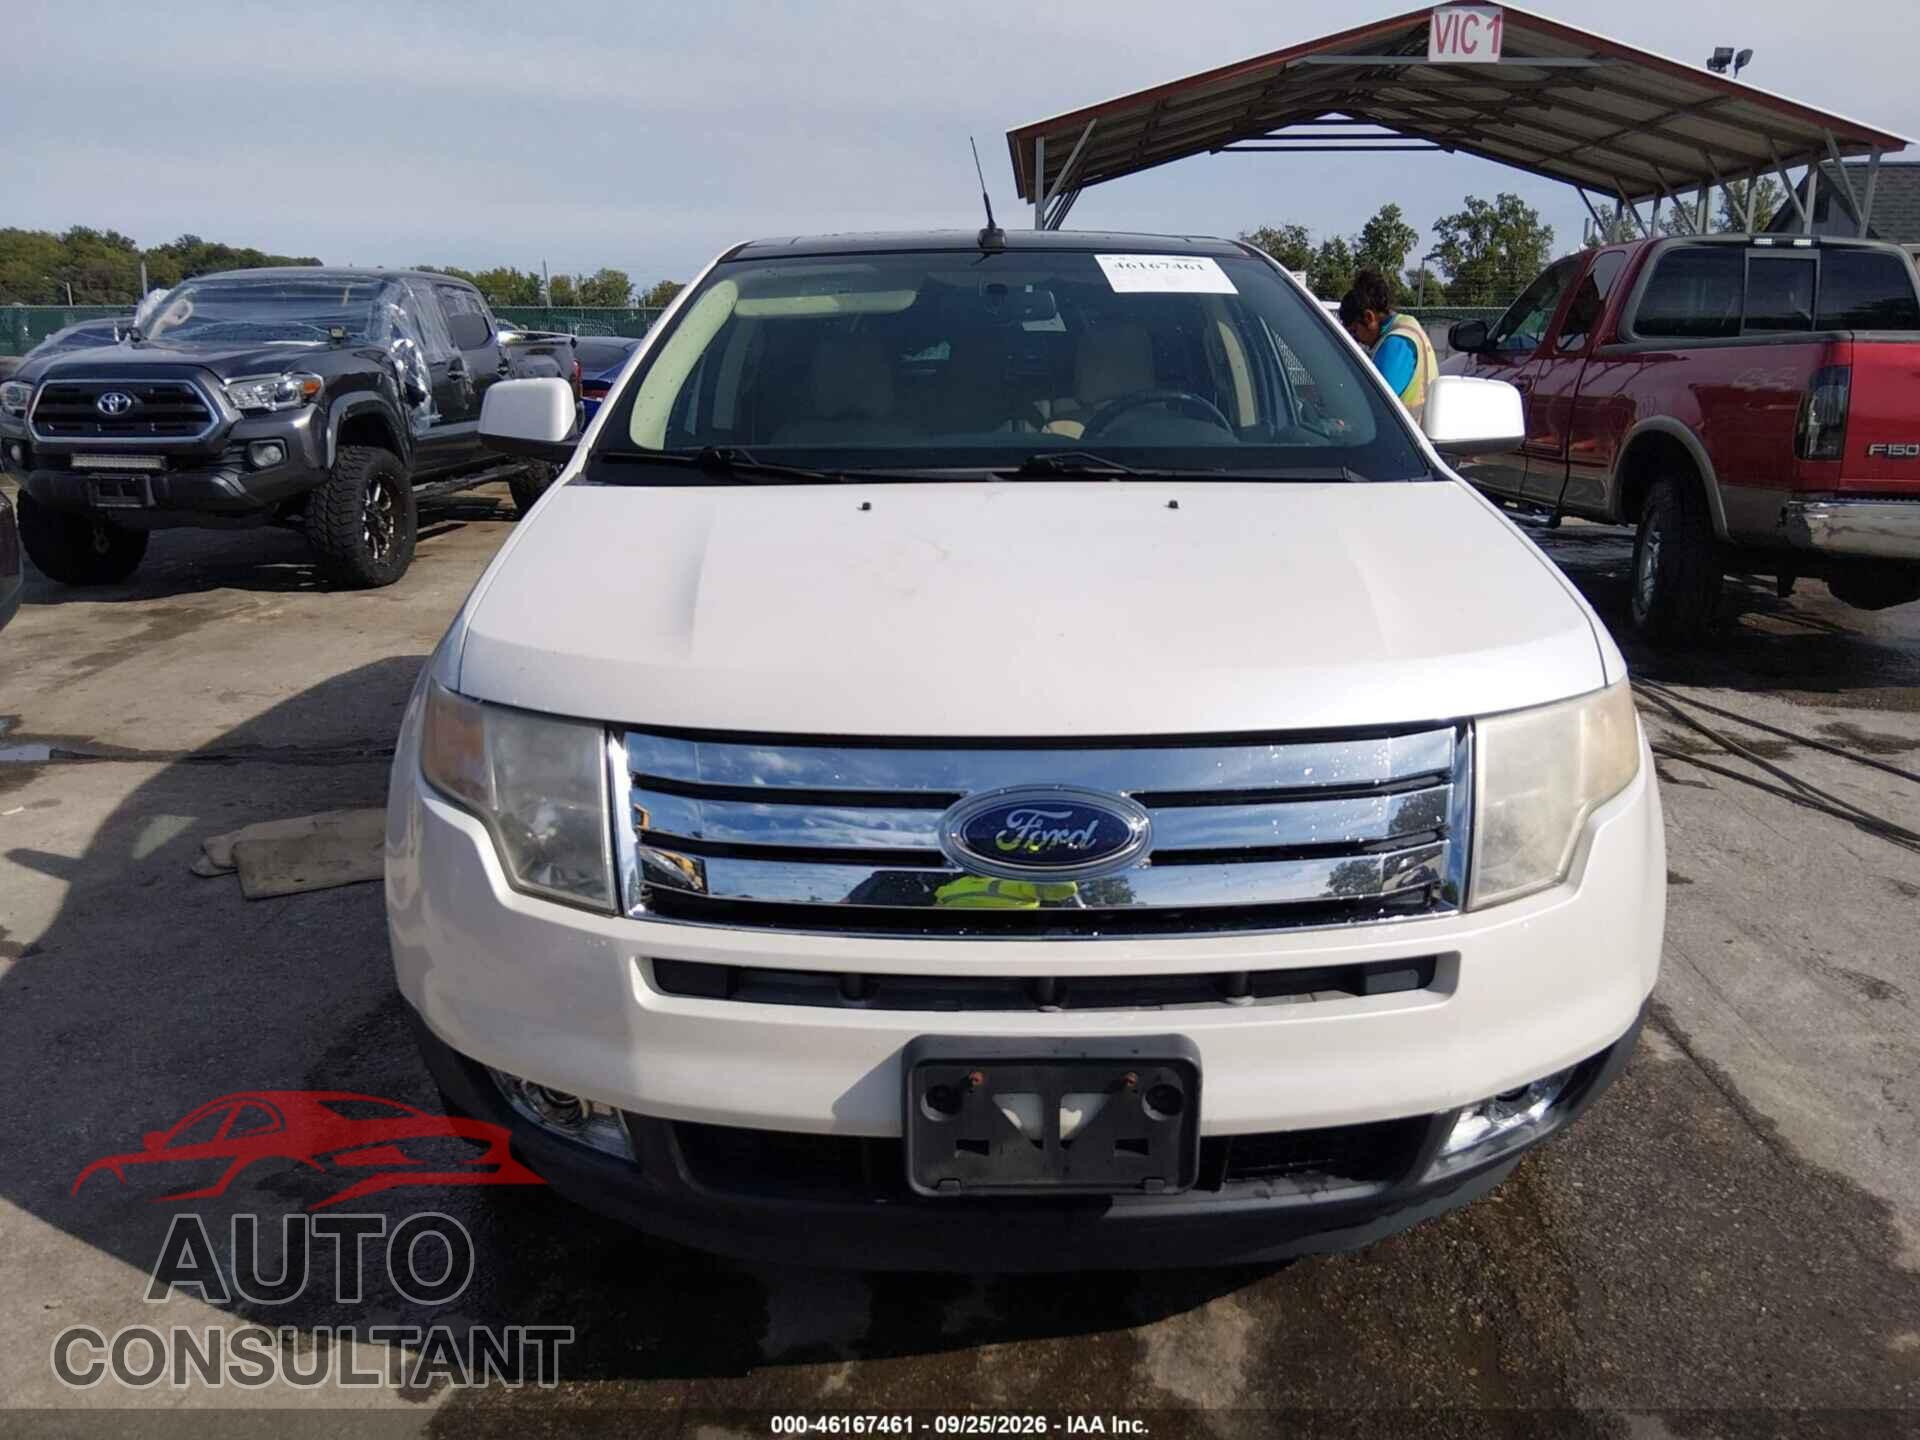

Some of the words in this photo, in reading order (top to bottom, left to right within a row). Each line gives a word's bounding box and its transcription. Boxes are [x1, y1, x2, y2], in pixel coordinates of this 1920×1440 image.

[1434, 13, 1480, 55] VIC
[1486, 13, 1501, 55] 1
[995, 808, 1099, 853] Ford
